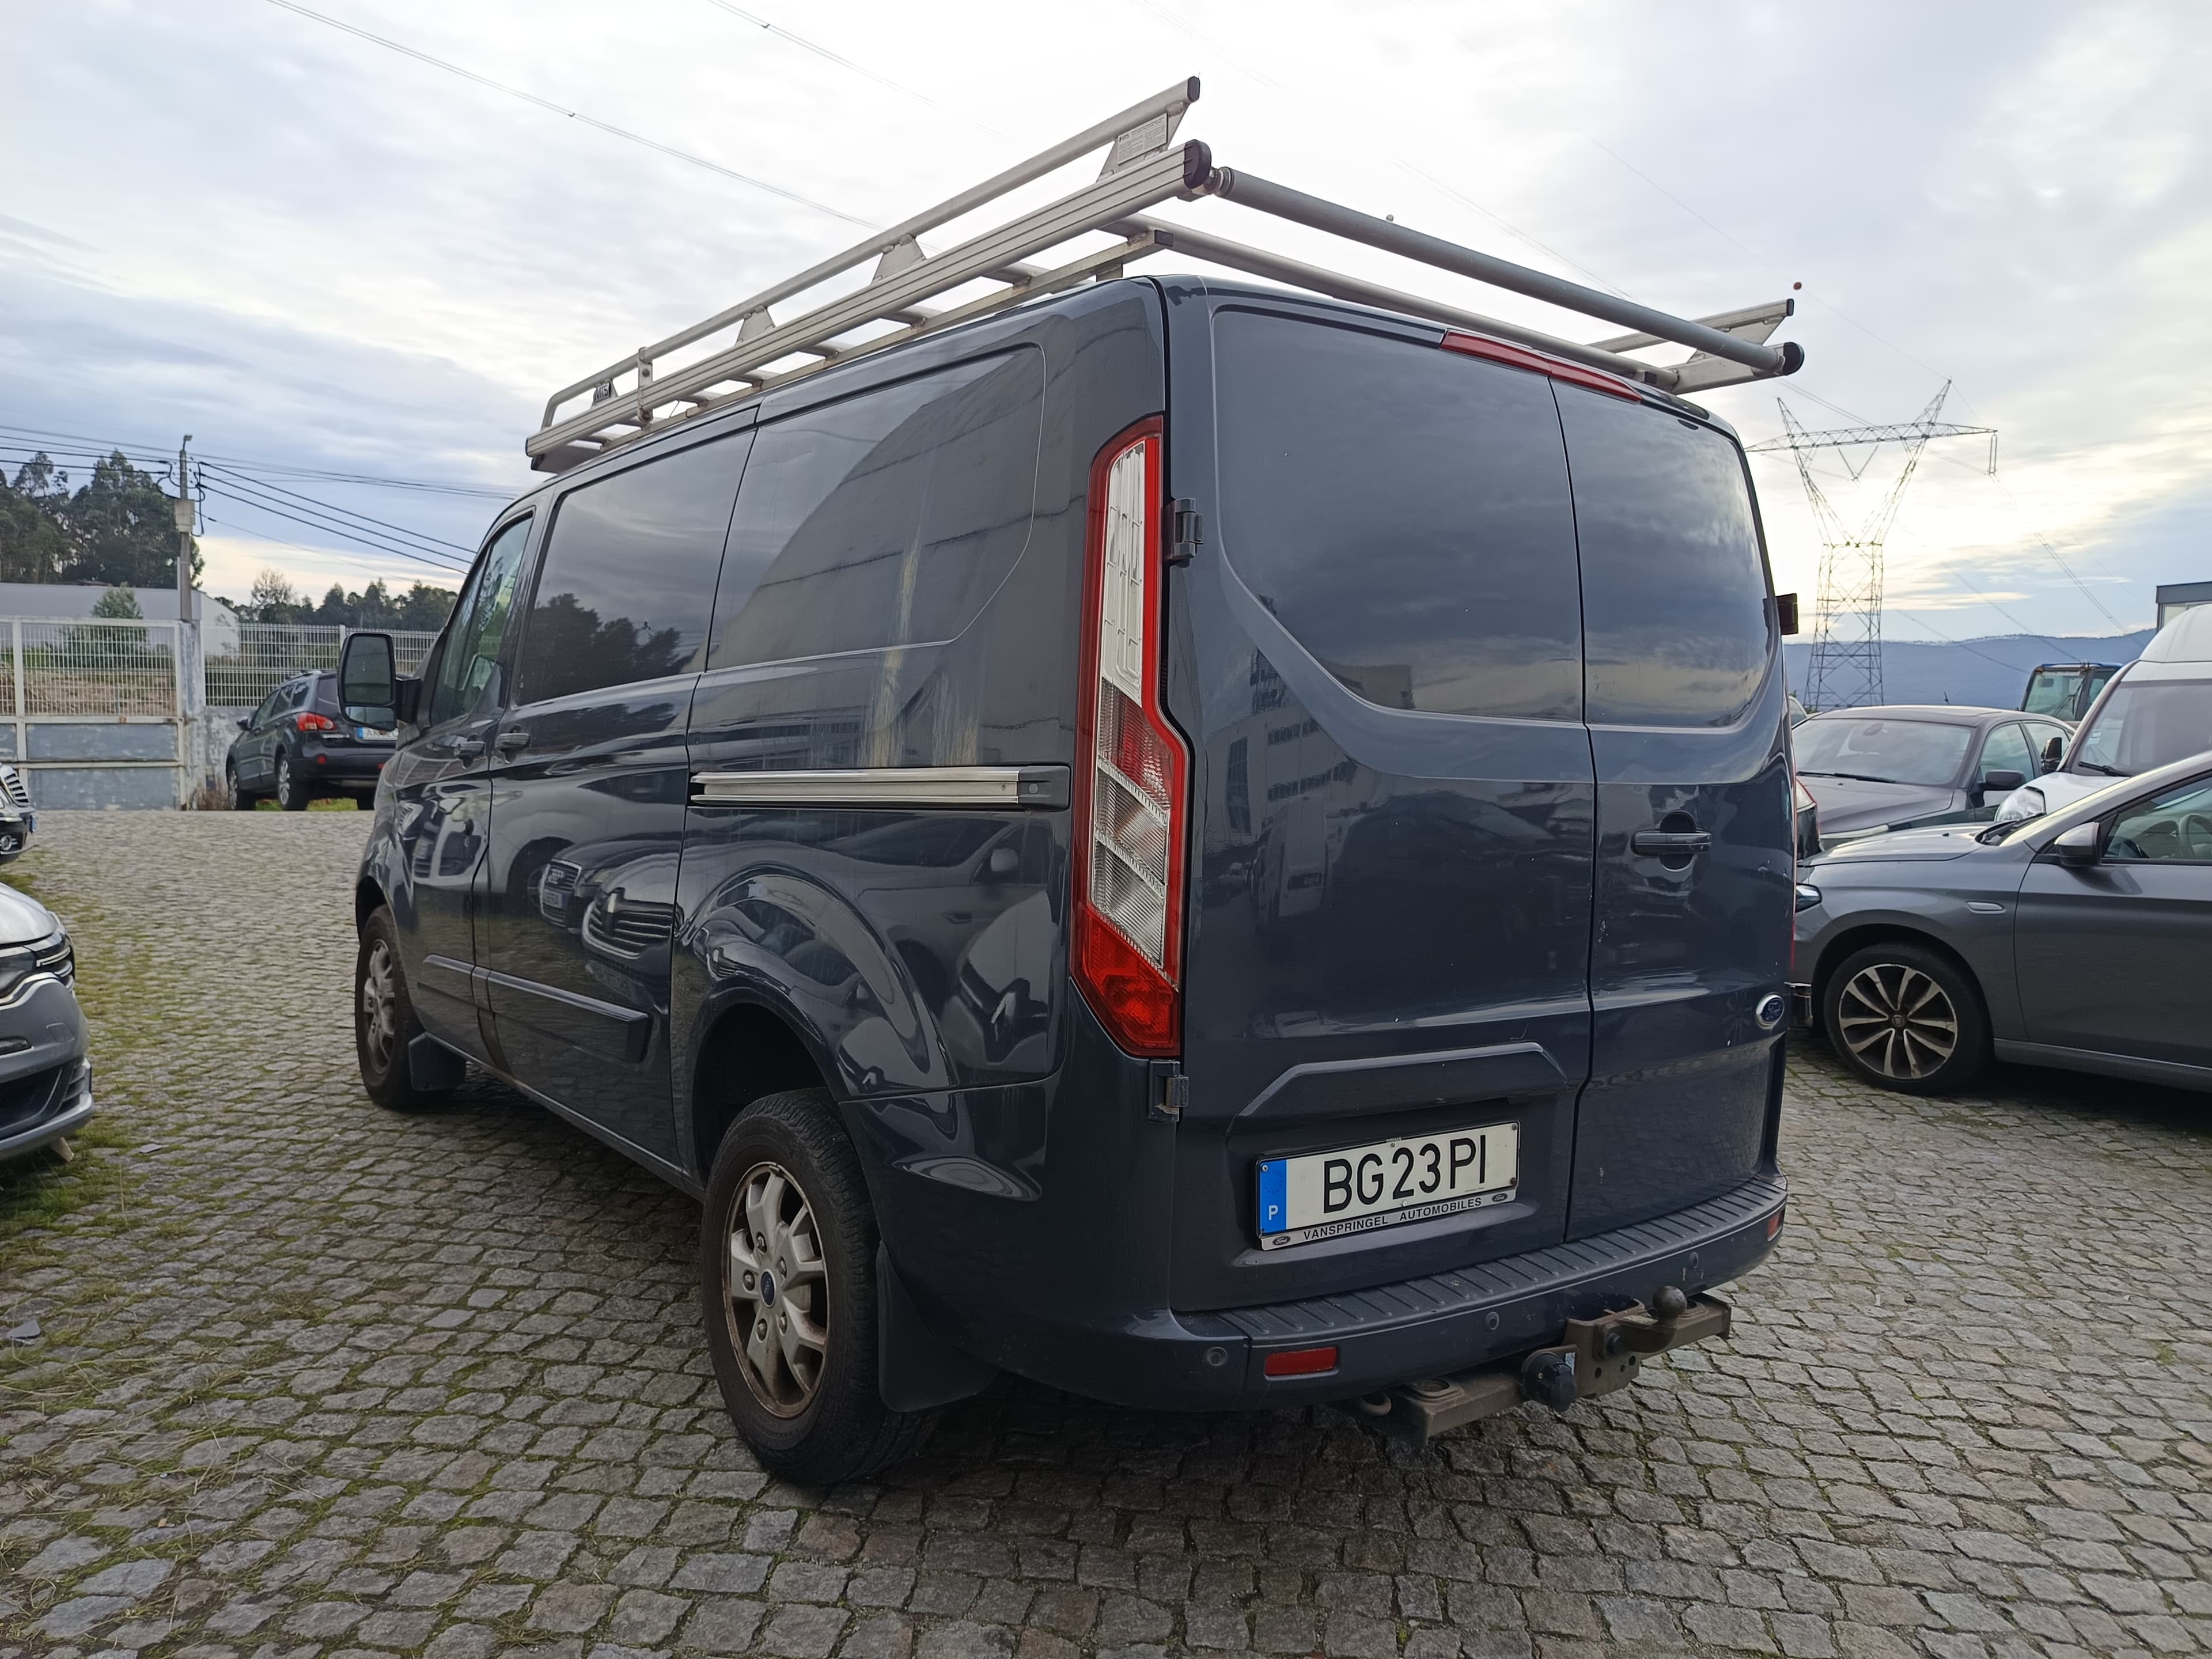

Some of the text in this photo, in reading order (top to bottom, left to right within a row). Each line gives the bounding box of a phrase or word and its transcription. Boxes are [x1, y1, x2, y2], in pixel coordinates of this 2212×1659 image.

[1268, 1205, 1279, 1221] P
[1304, 1197, 1482, 1240] VANSPRINGEL AUTOMOBILES
[1274, 1237, 1289, 1245] Ford
